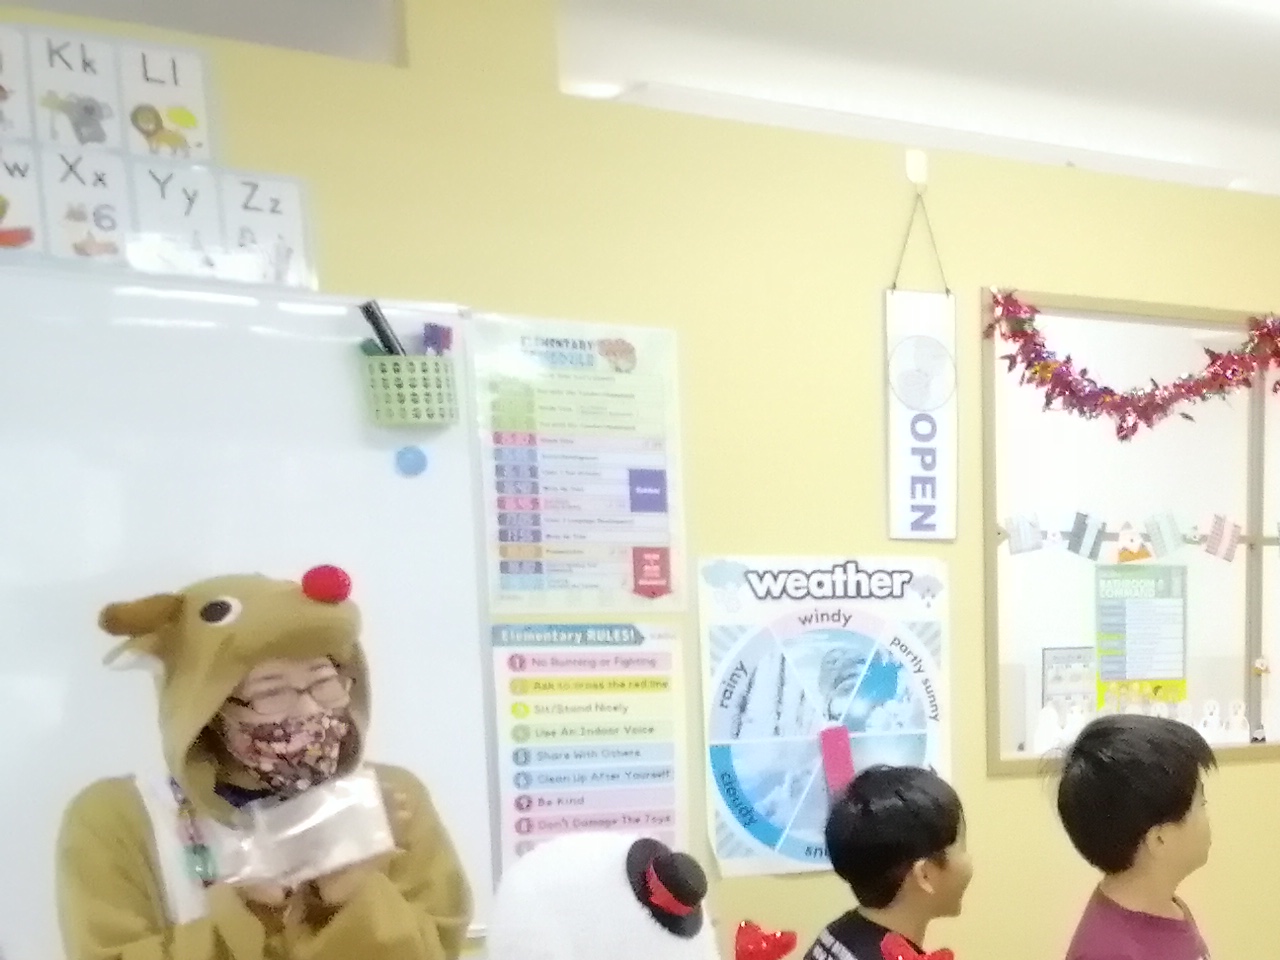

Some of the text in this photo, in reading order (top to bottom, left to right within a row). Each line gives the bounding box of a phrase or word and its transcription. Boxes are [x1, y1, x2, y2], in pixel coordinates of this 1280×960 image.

[909, 411, 938, 532] OPEN
[744, 560, 914, 600] weather
[501, 629, 583, 645] Elementary
[586, 628, 636, 643] RULES!
[797, 608, 853, 628] windy
[718, 659, 749, 710] rainy
[889, 636, 940, 723] partly sunny
[720, 771, 760, 829] cloudy
